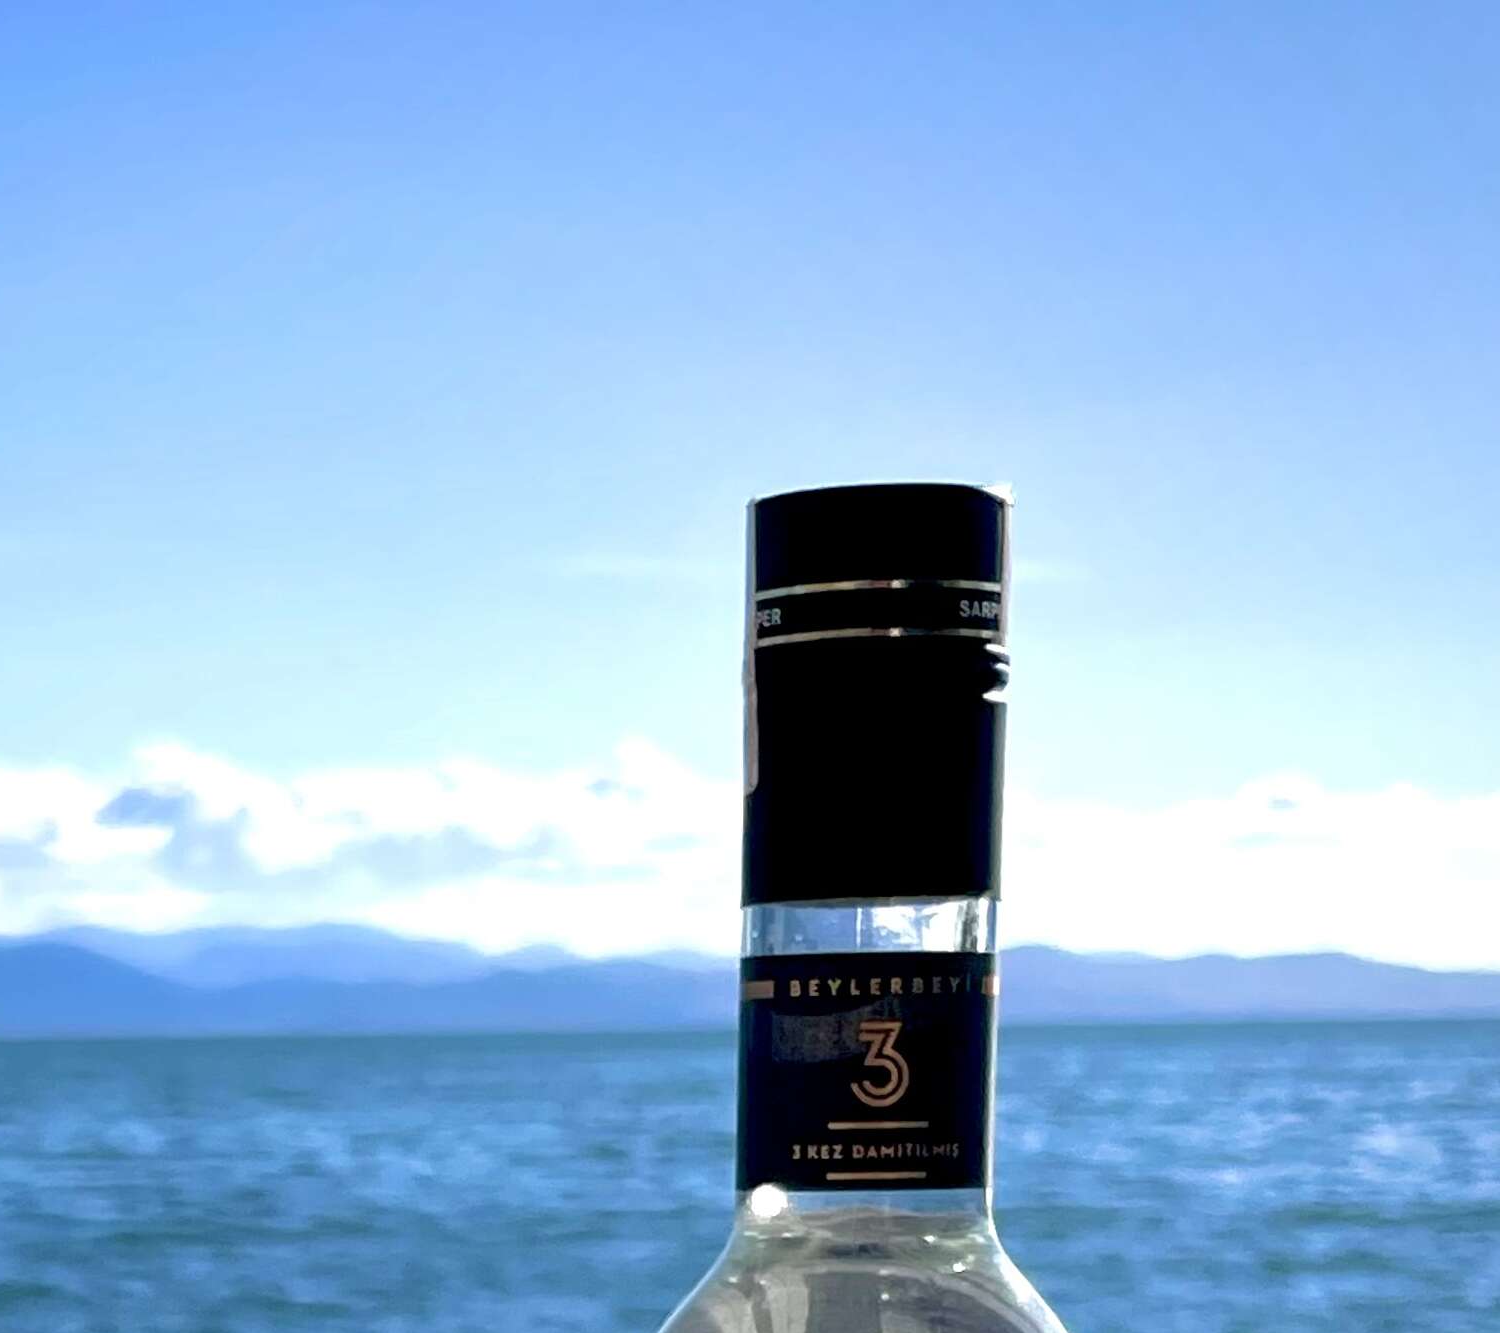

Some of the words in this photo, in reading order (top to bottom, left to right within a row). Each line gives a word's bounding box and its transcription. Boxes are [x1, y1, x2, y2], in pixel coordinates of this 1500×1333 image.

[850, 1020, 910, 1108] 3
[792, 1144, 802, 1160] 3
[807, 1144, 844, 1160] KEZ
